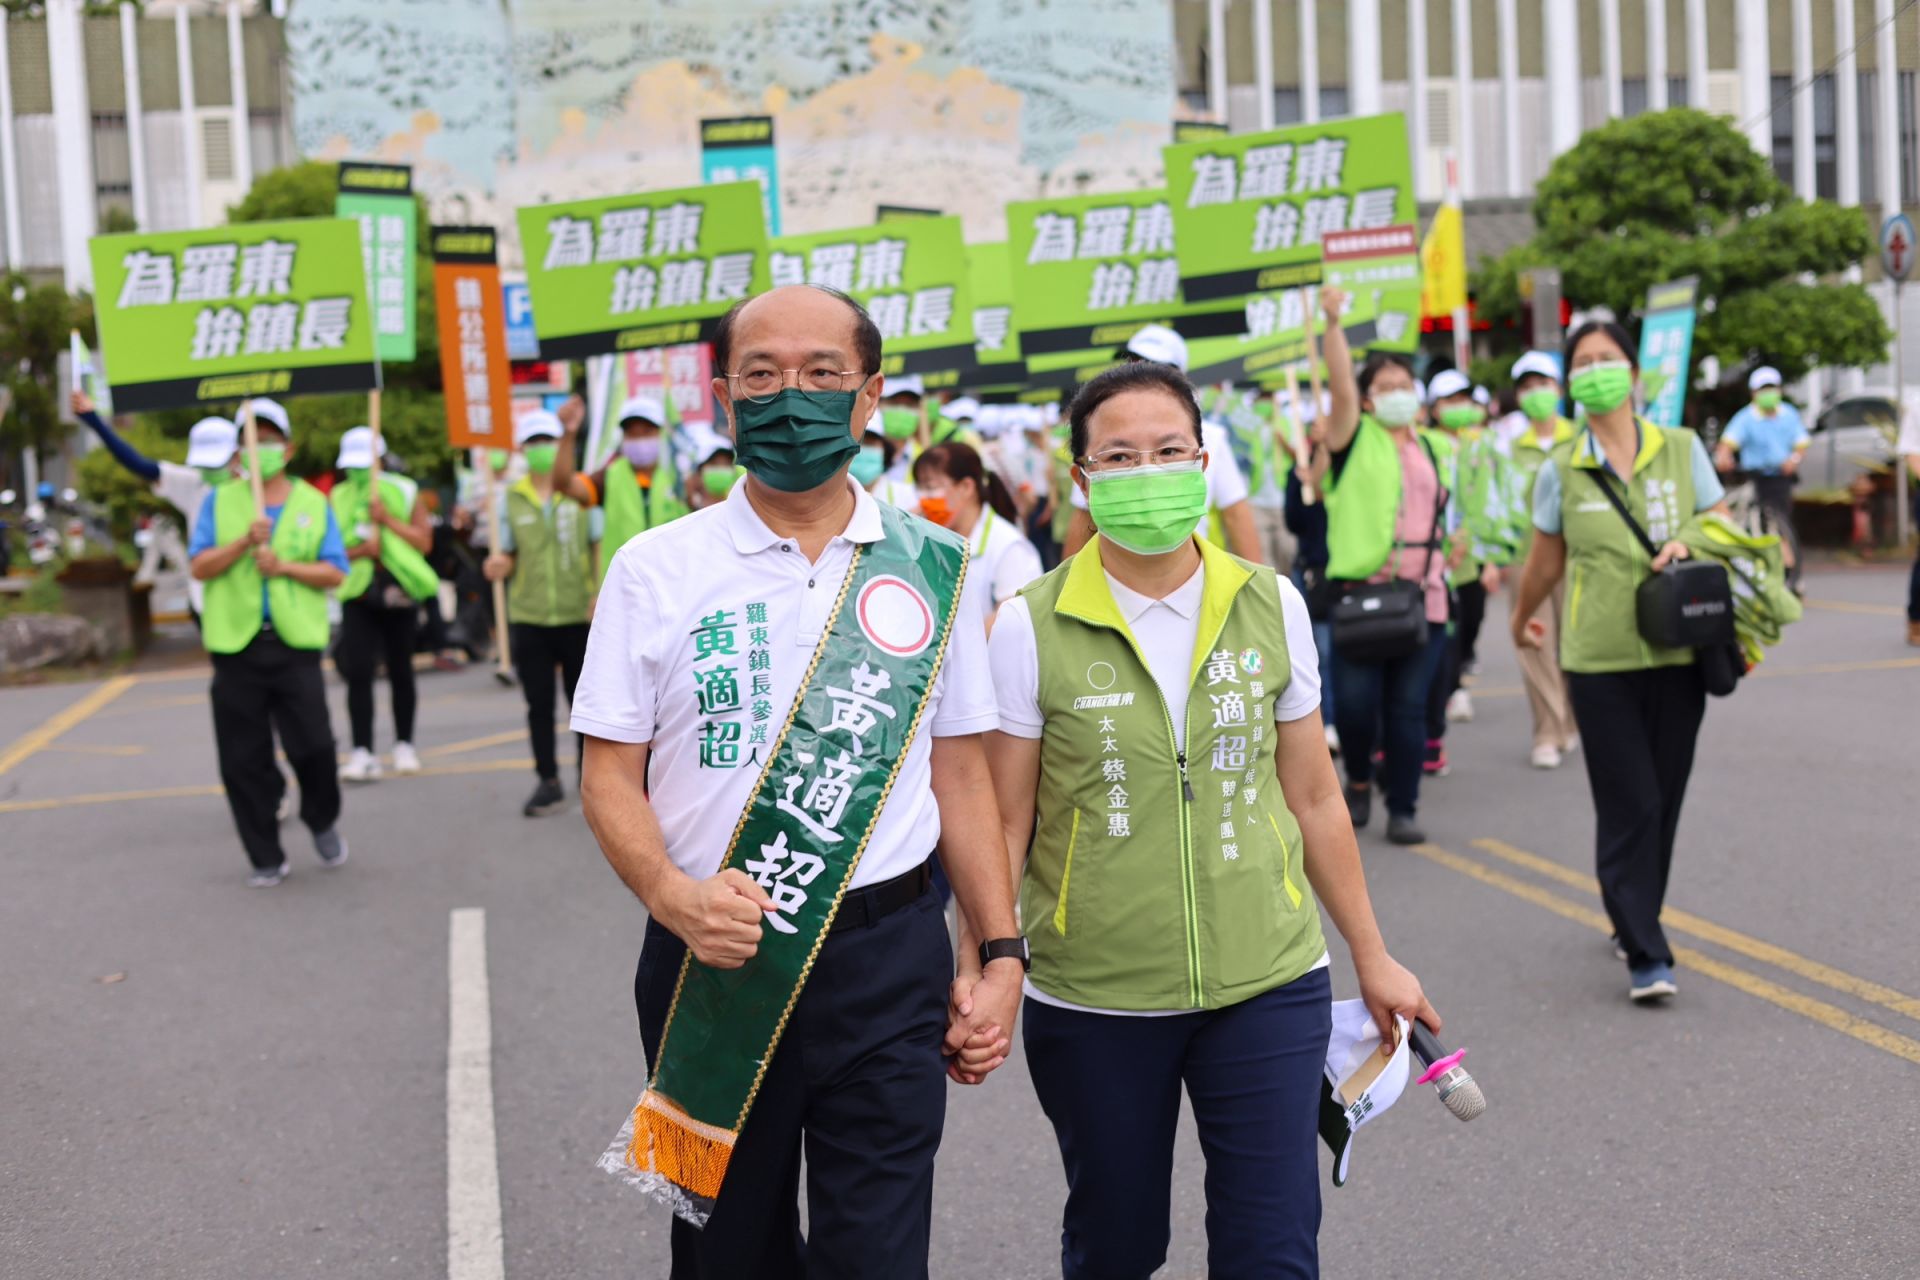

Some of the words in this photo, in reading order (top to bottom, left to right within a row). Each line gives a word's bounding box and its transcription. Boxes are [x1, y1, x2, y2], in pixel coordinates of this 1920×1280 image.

[1187, 137, 1348, 208] 為羅東
[117, 240, 297, 309] 為羅東
[543, 200, 704, 271] 為羅東
[690, 609, 743, 769] 黃適超
[743, 602, 773, 768] 羅東鎮長參選人
[1205, 648, 1249, 772] 黃適超
[745, 661, 897, 934] 黃適超
[1219, 780, 1240, 862] 競選團隊
